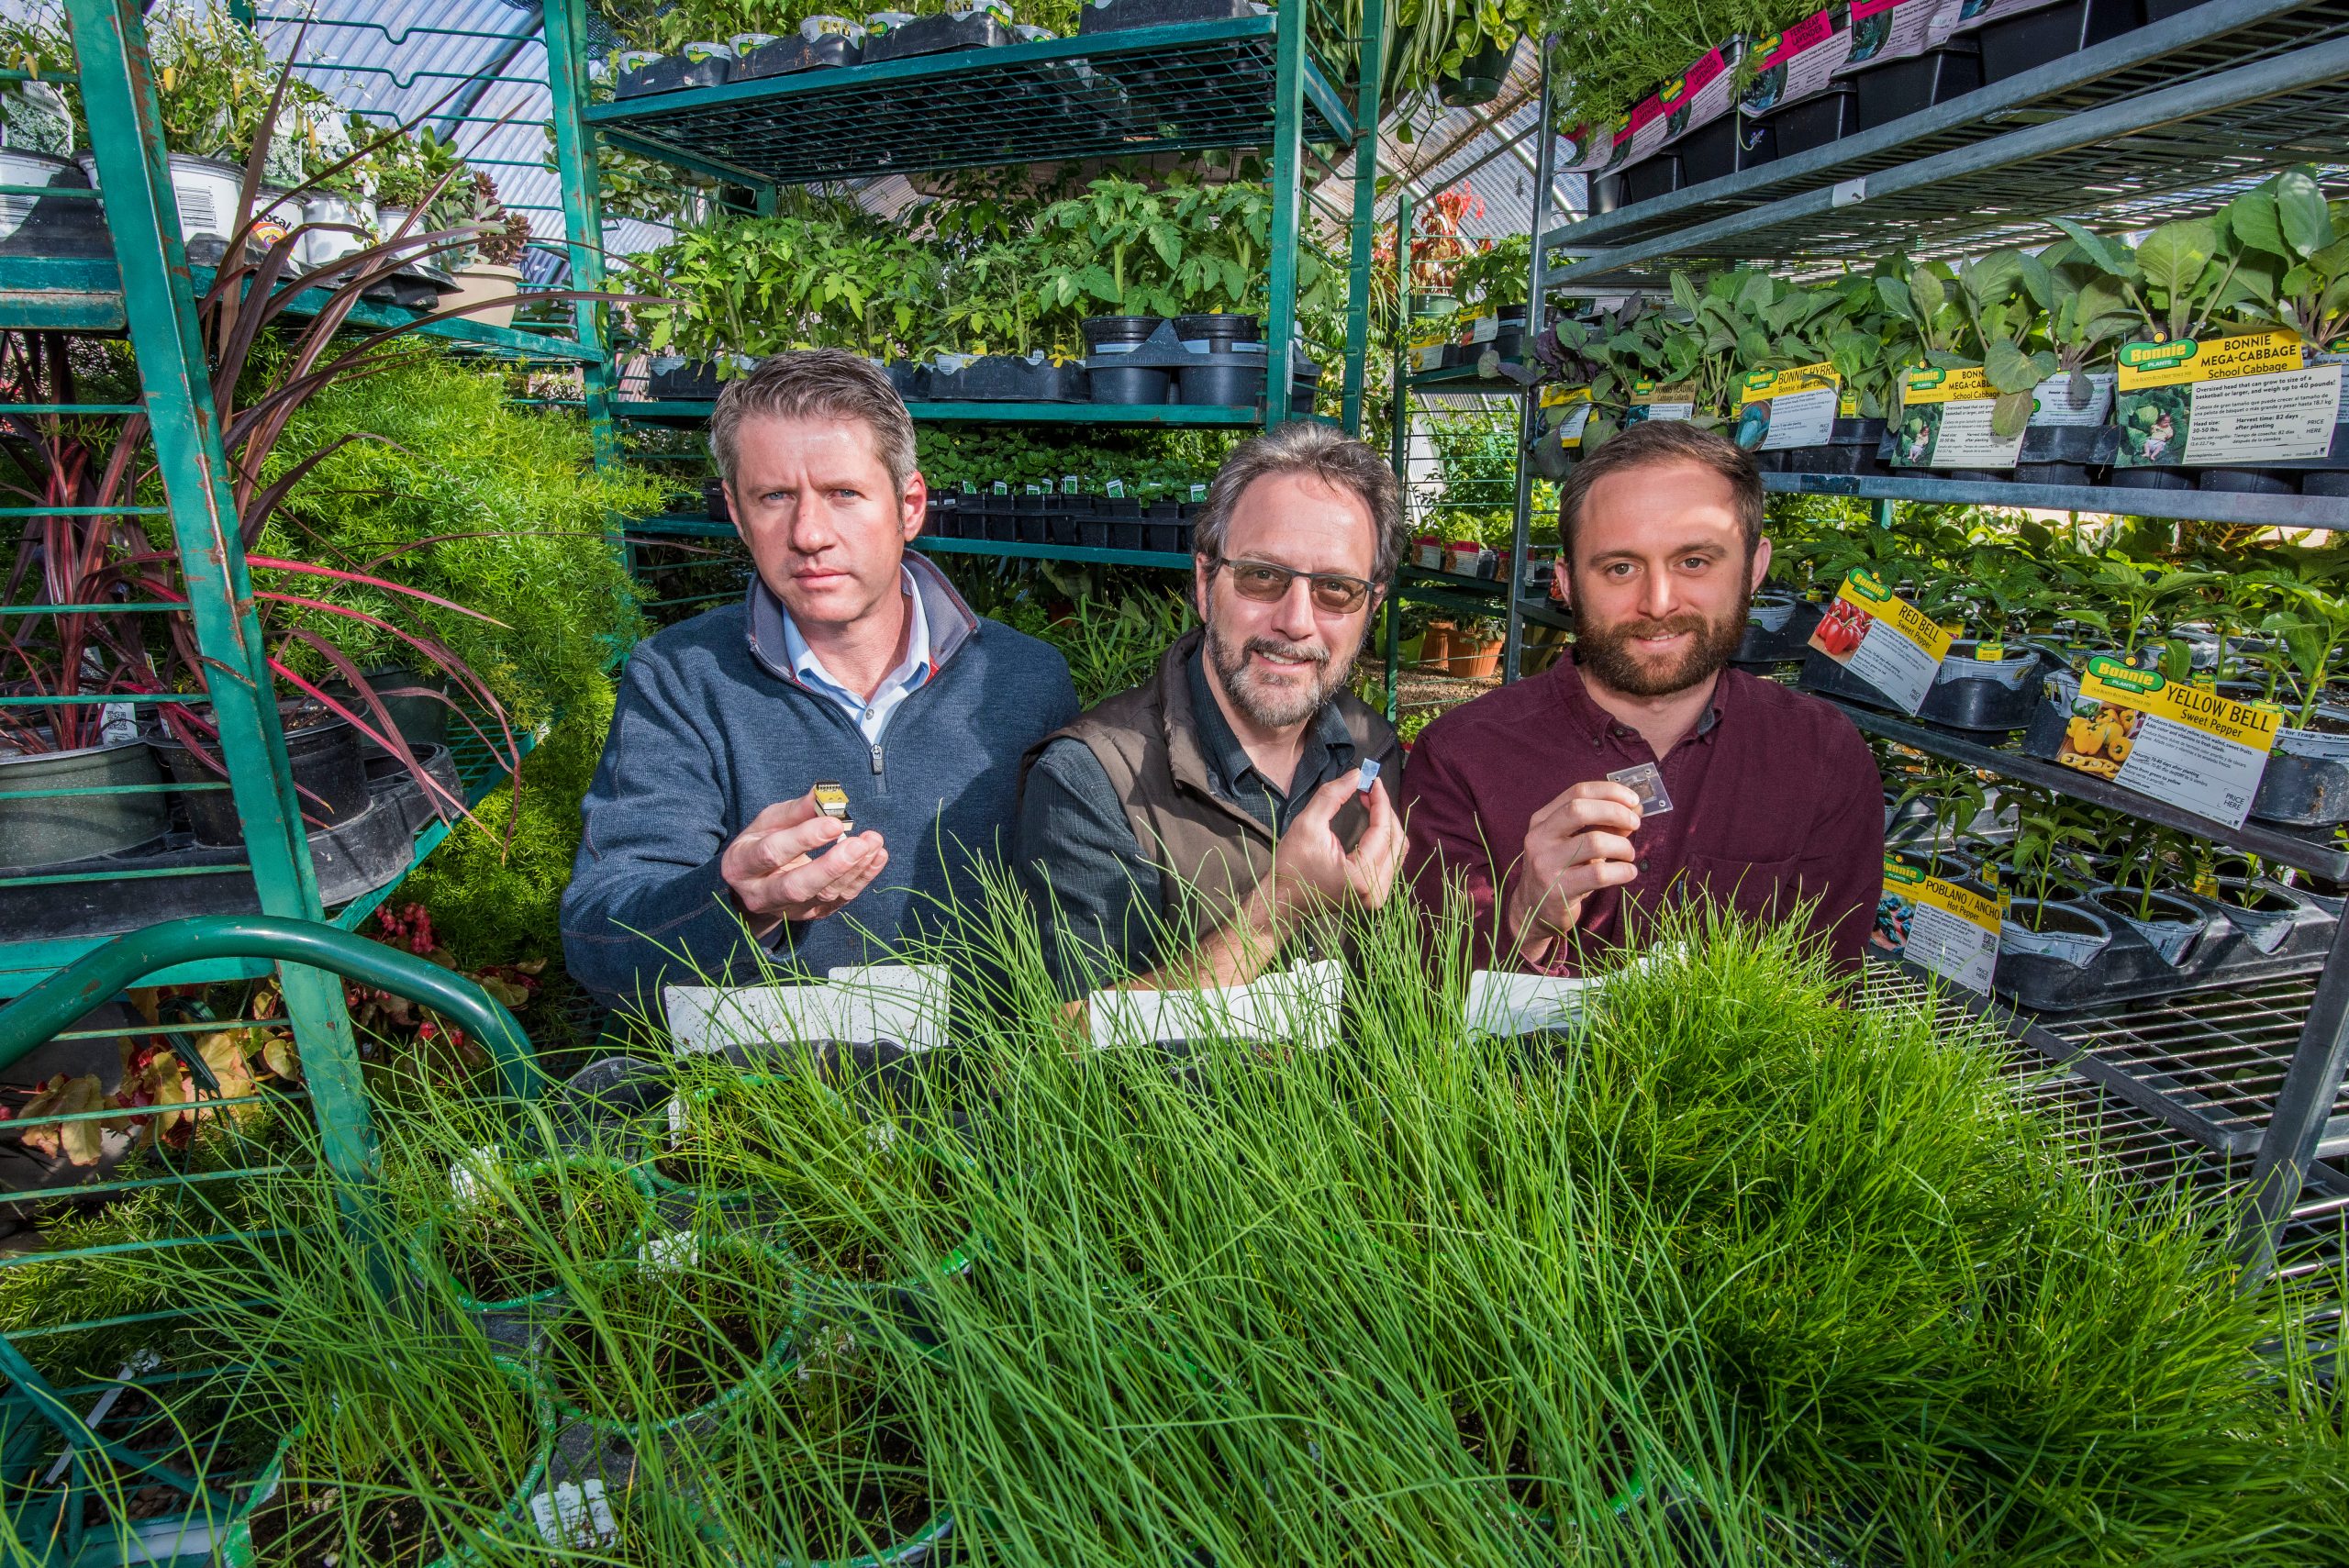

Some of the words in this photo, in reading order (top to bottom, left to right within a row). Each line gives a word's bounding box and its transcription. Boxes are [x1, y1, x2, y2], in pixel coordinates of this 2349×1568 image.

[1788, 14, 1820, 39] FERNLEAF
[1791, 22, 1823, 46] LAVENDER
[1690, 53, 1714, 77] FERNLEAF
[1693, 61, 1718, 85] LAVENDER
[2131, 341, 2186, 362] Bonnie
[2223, 334, 2271, 350] BONNIE
[2147, 359, 2171, 367] PLANTS
[2200, 344, 2297, 367] MEGA-CABBAGE
[1961, 368, 1985, 379] BONN
[2208, 366, 2240, 379] School
[2242, 360, 2288, 376] Cabbage
[1674, 384, 1695, 394] HEADING
[1799, 380, 1811, 390] Best
[1947, 378, 1993, 392] MEGA-CABB
[1952, 390, 1973, 400] School
[1973, 388, 2001, 399] Cabbage
[2231, 389, 2249, 397] larger,
[2263, 385, 2280, 394] weigh
[2310, 379, 2335, 388] pounds!
[1853, 573, 1887, 596] Bonnie
[1898, 604, 1920, 626] RED
[1917, 617, 1942, 643] BELL
[1896, 618, 1914, 636] Sweet
[1912, 631, 1932, 651] Pepper
[2098, 659, 2155, 688] Bonnie
[1910, 687, 1921, 698] PRICE
[2111, 678, 2136, 690] PLANTS
[1909, 692, 1919, 703] HERE
[2162, 684, 2227, 717] YELLOW
[2227, 705, 2274, 733] BELL
[2179, 708, 2210, 726] Sweet
[2208, 718, 2243, 740] Pepper
[2147, 716, 2168, 726] Produces
[2167, 722, 2187, 732] beautiful
[2186, 728, 2201, 738] yellow,
[2210, 737, 2226, 746] walled,
[2225, 742, 2239, 751] sweet
[2239, 747, 2254, 755] fruits.
[2176, 732, 2195, 741] vitamins
[2210, 744, 2225, 752] salads.
[2223, 799, 2241, 810] HERE
[2225, 793, 2244, 805] PRICE
[1884, 862, 1917, 879] onnie
[1925, 878, 1967, 906] POBLANO
[1967, 895, 1973, 907] /
[1974, 899, 2000, 920] ANCHO
[1946, 900, 1958, 911] Hot
[1959, 906, 1979, 921] Pepper
[1976, 966, 1988, 976] PRICE
[1976, 972, 1987, 981] HERE
